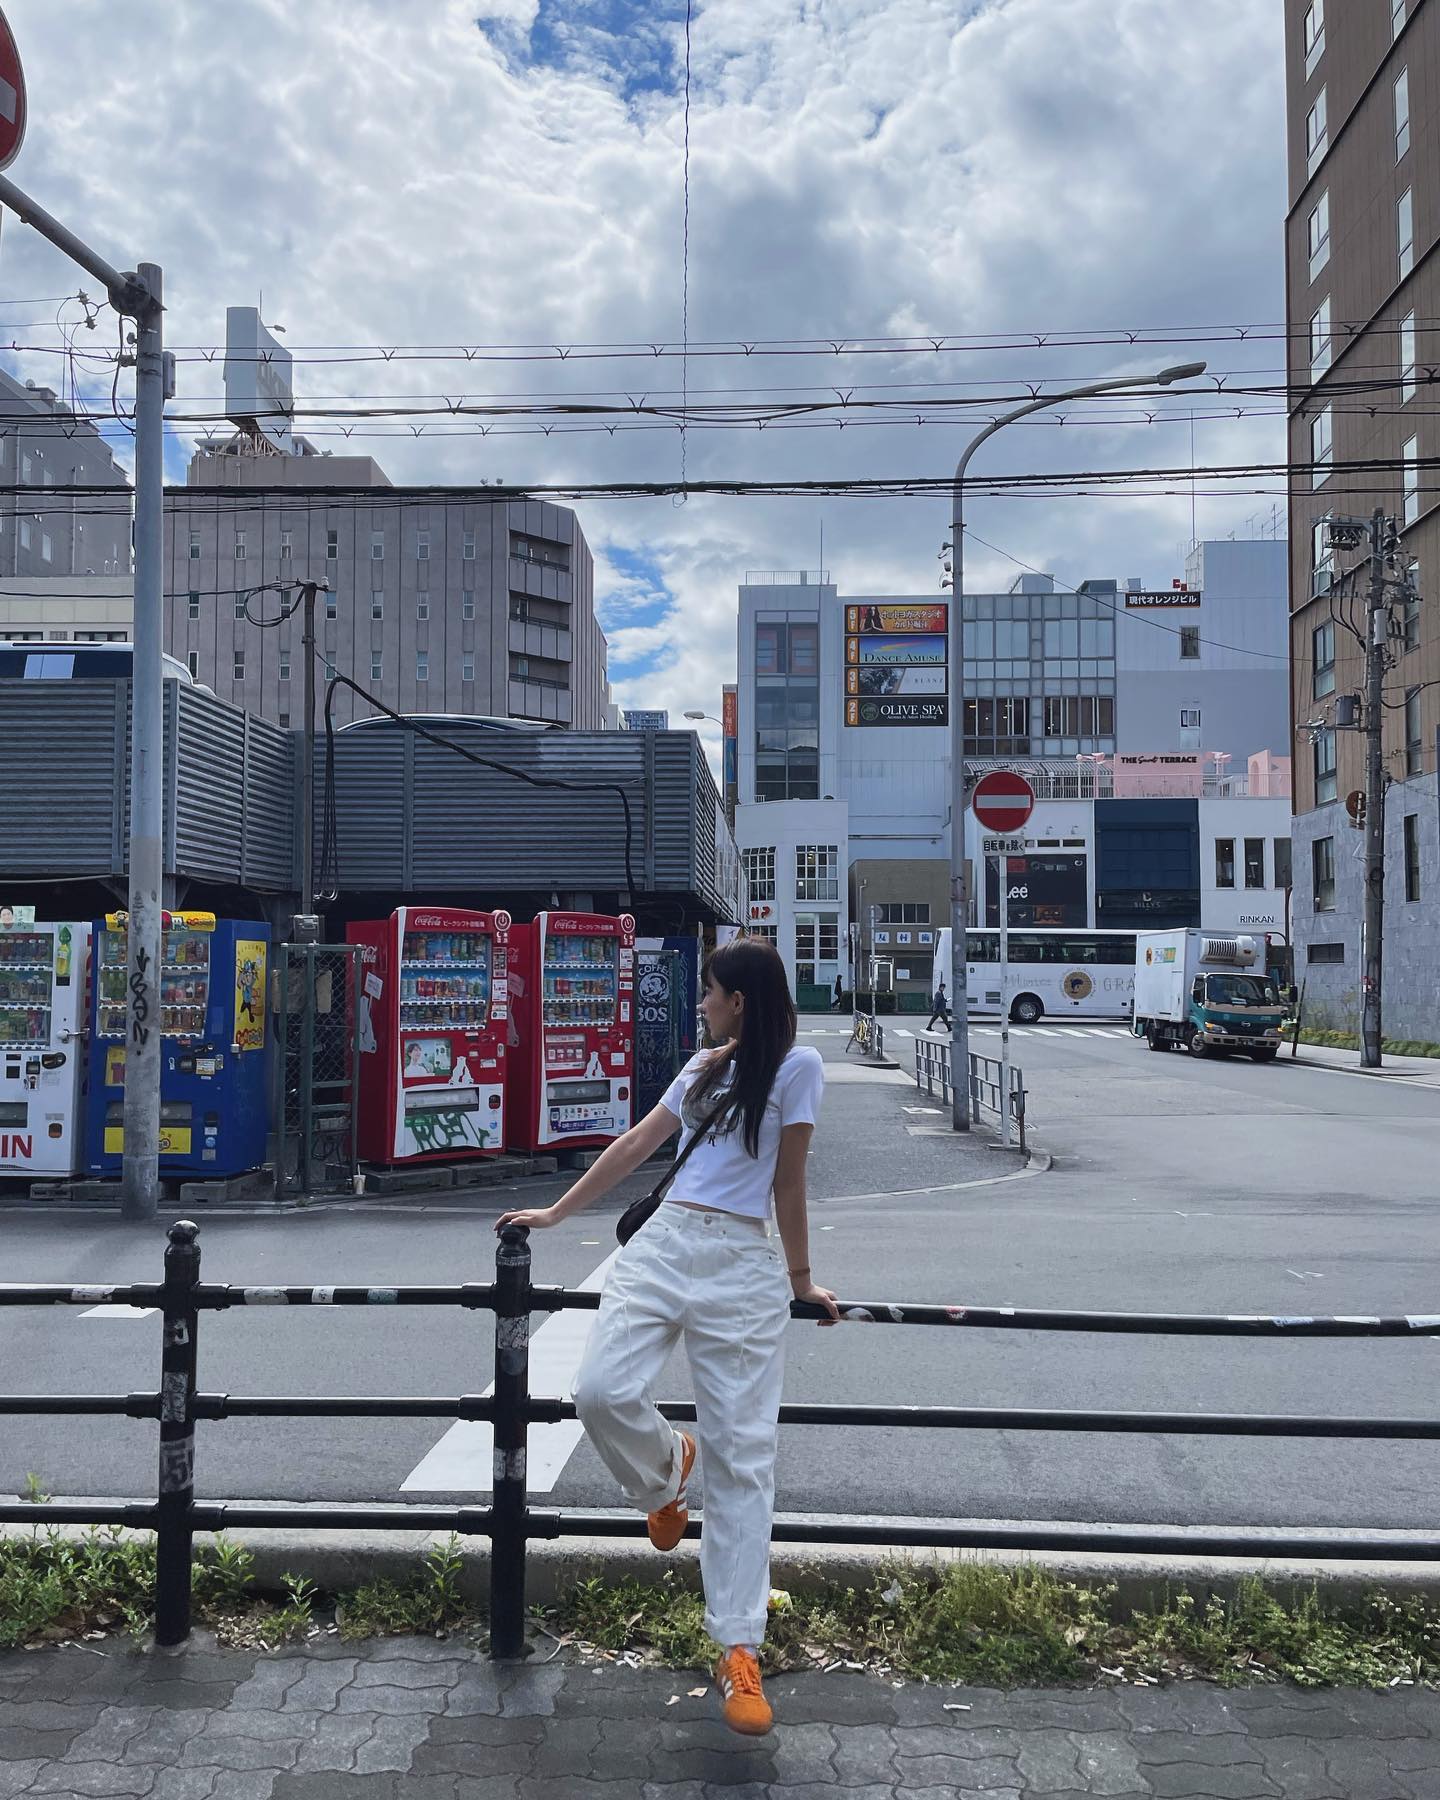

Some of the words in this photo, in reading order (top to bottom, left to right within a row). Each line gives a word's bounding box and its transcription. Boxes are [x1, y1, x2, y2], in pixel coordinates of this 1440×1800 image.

[1128, 596, 1197, 605] 現代オレンジビル
[864, 653, 899, 662] DANCE
[880, 704, 919, 715] OLIVE
[922, 704, 943, 715] SPA
[1120, 756, 1137, 764] THE
[1159, 756, 1197, 764] TERRACE
[983, 839, 1024, 851] 自転車を除く
[1239, 914, 1275, 924] RINKAN
[1, 1134, 33, 1159] IN
